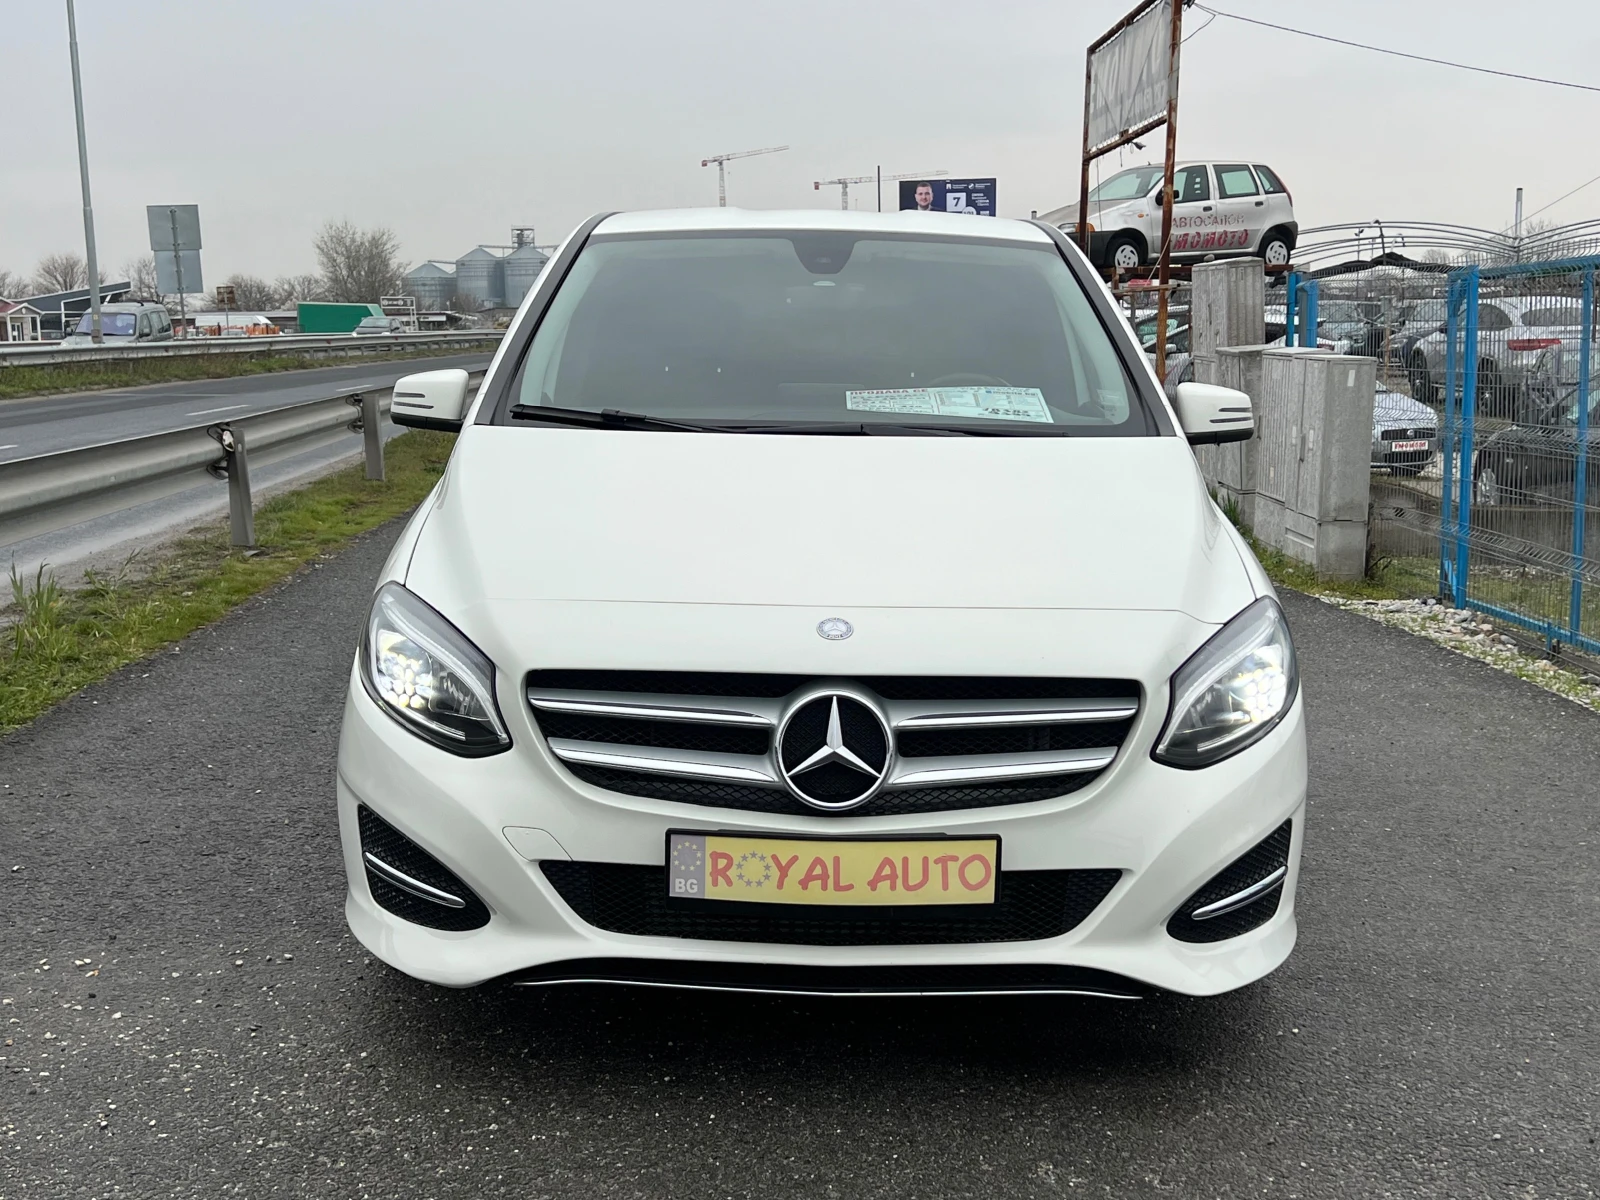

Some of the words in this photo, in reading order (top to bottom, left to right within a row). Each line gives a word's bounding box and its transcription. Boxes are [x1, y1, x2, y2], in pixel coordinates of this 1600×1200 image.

[953, 196, 961, 207] 7
[867, 852, 992, 892] AUTO
[674, 878, 698, 893] BG
